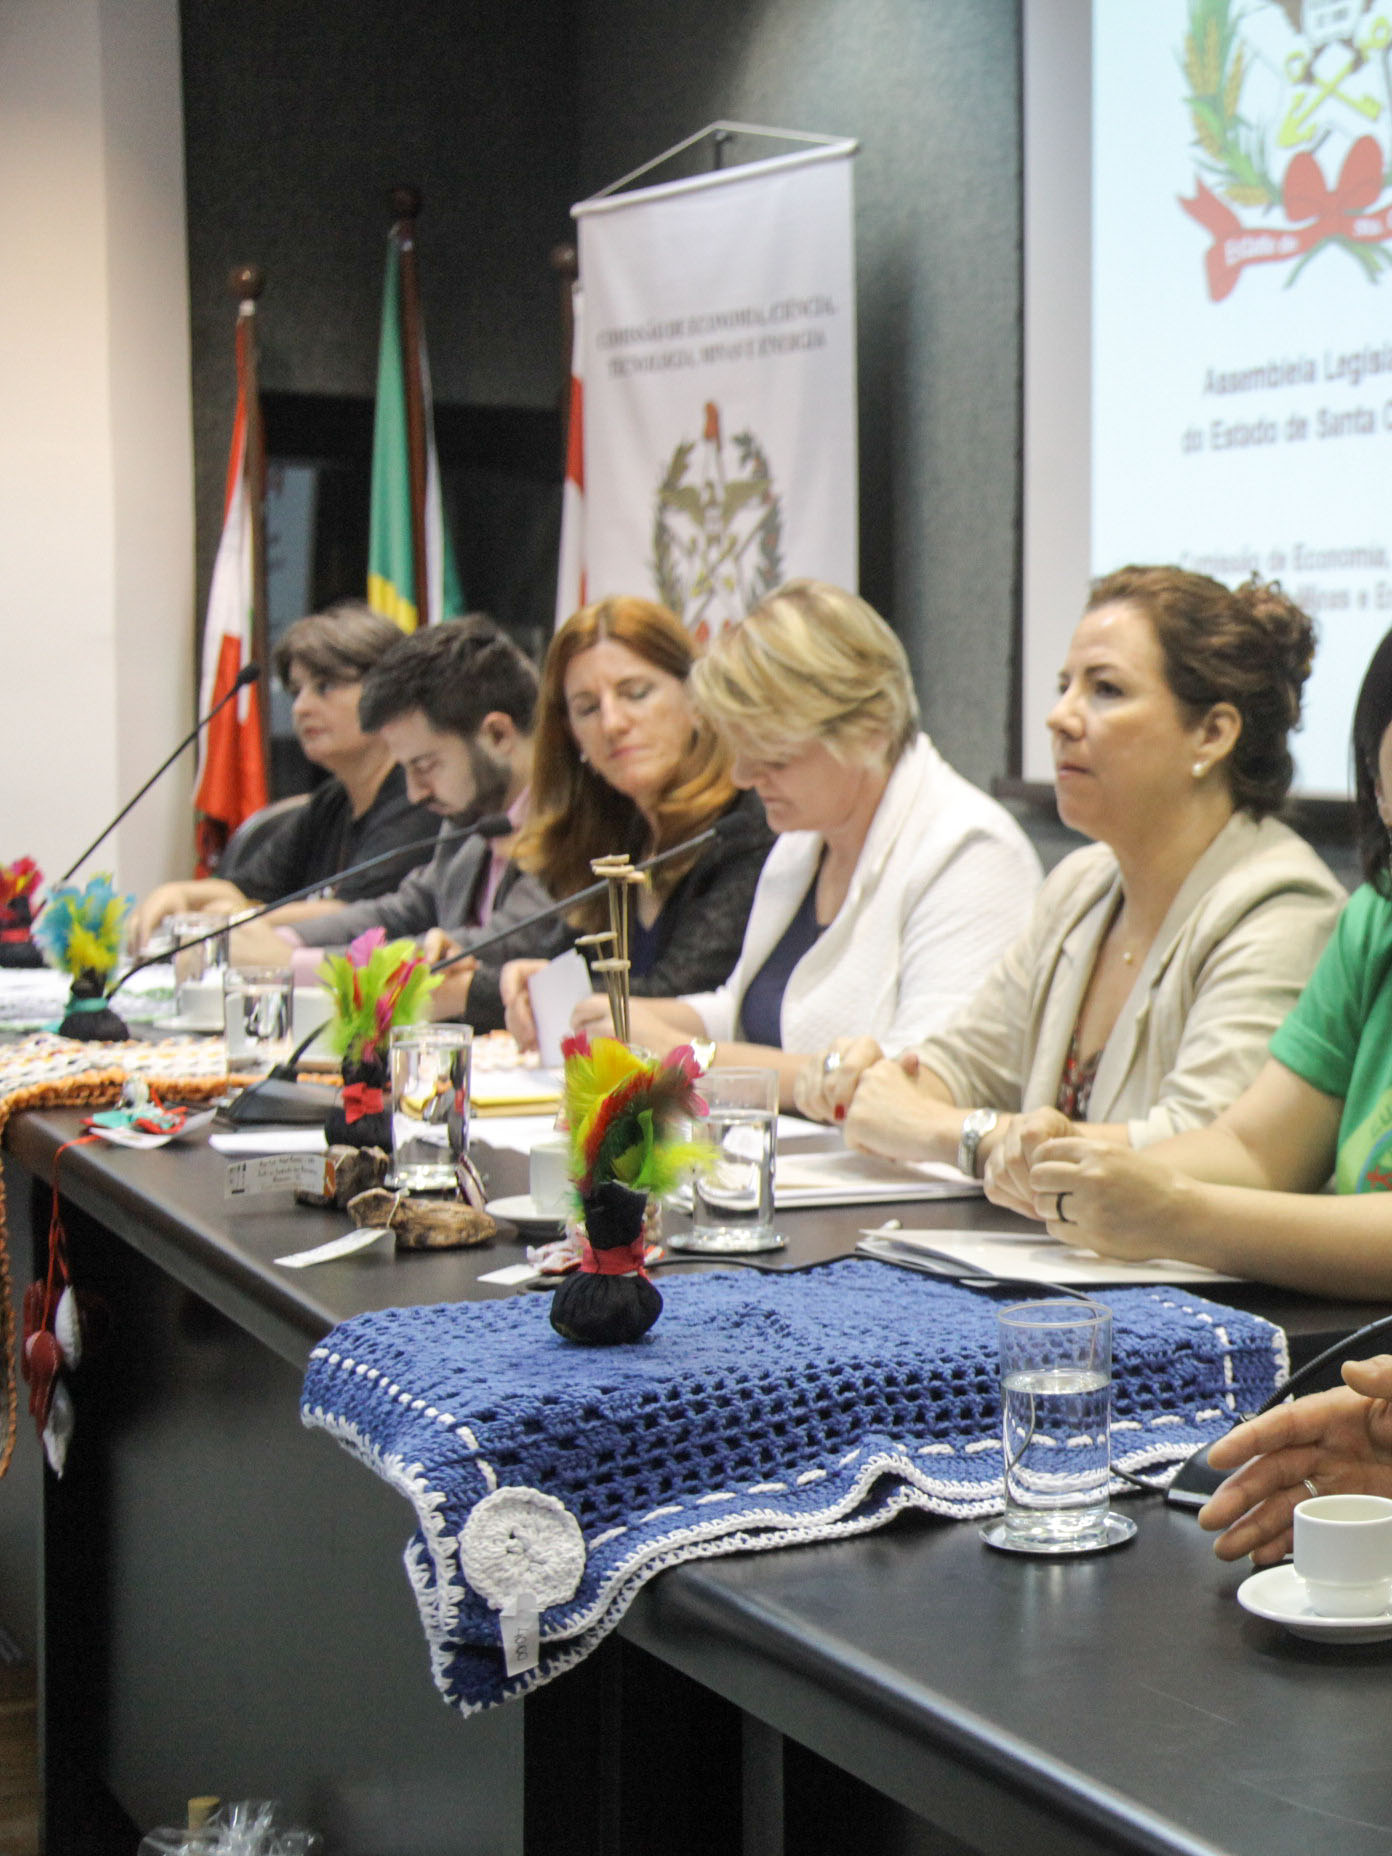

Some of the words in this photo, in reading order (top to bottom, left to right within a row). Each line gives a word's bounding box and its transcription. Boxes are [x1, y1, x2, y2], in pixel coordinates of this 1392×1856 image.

[1203, 359, 1316, 395] Assembleia
[1182, 424, 1203, 454] do
[1210, 417, 1278, 450] Estado
[1285, 412, 1308, 443] de
[1316, 406, 1376, 439] Santa
[1268, 545, 1287, 572] de
